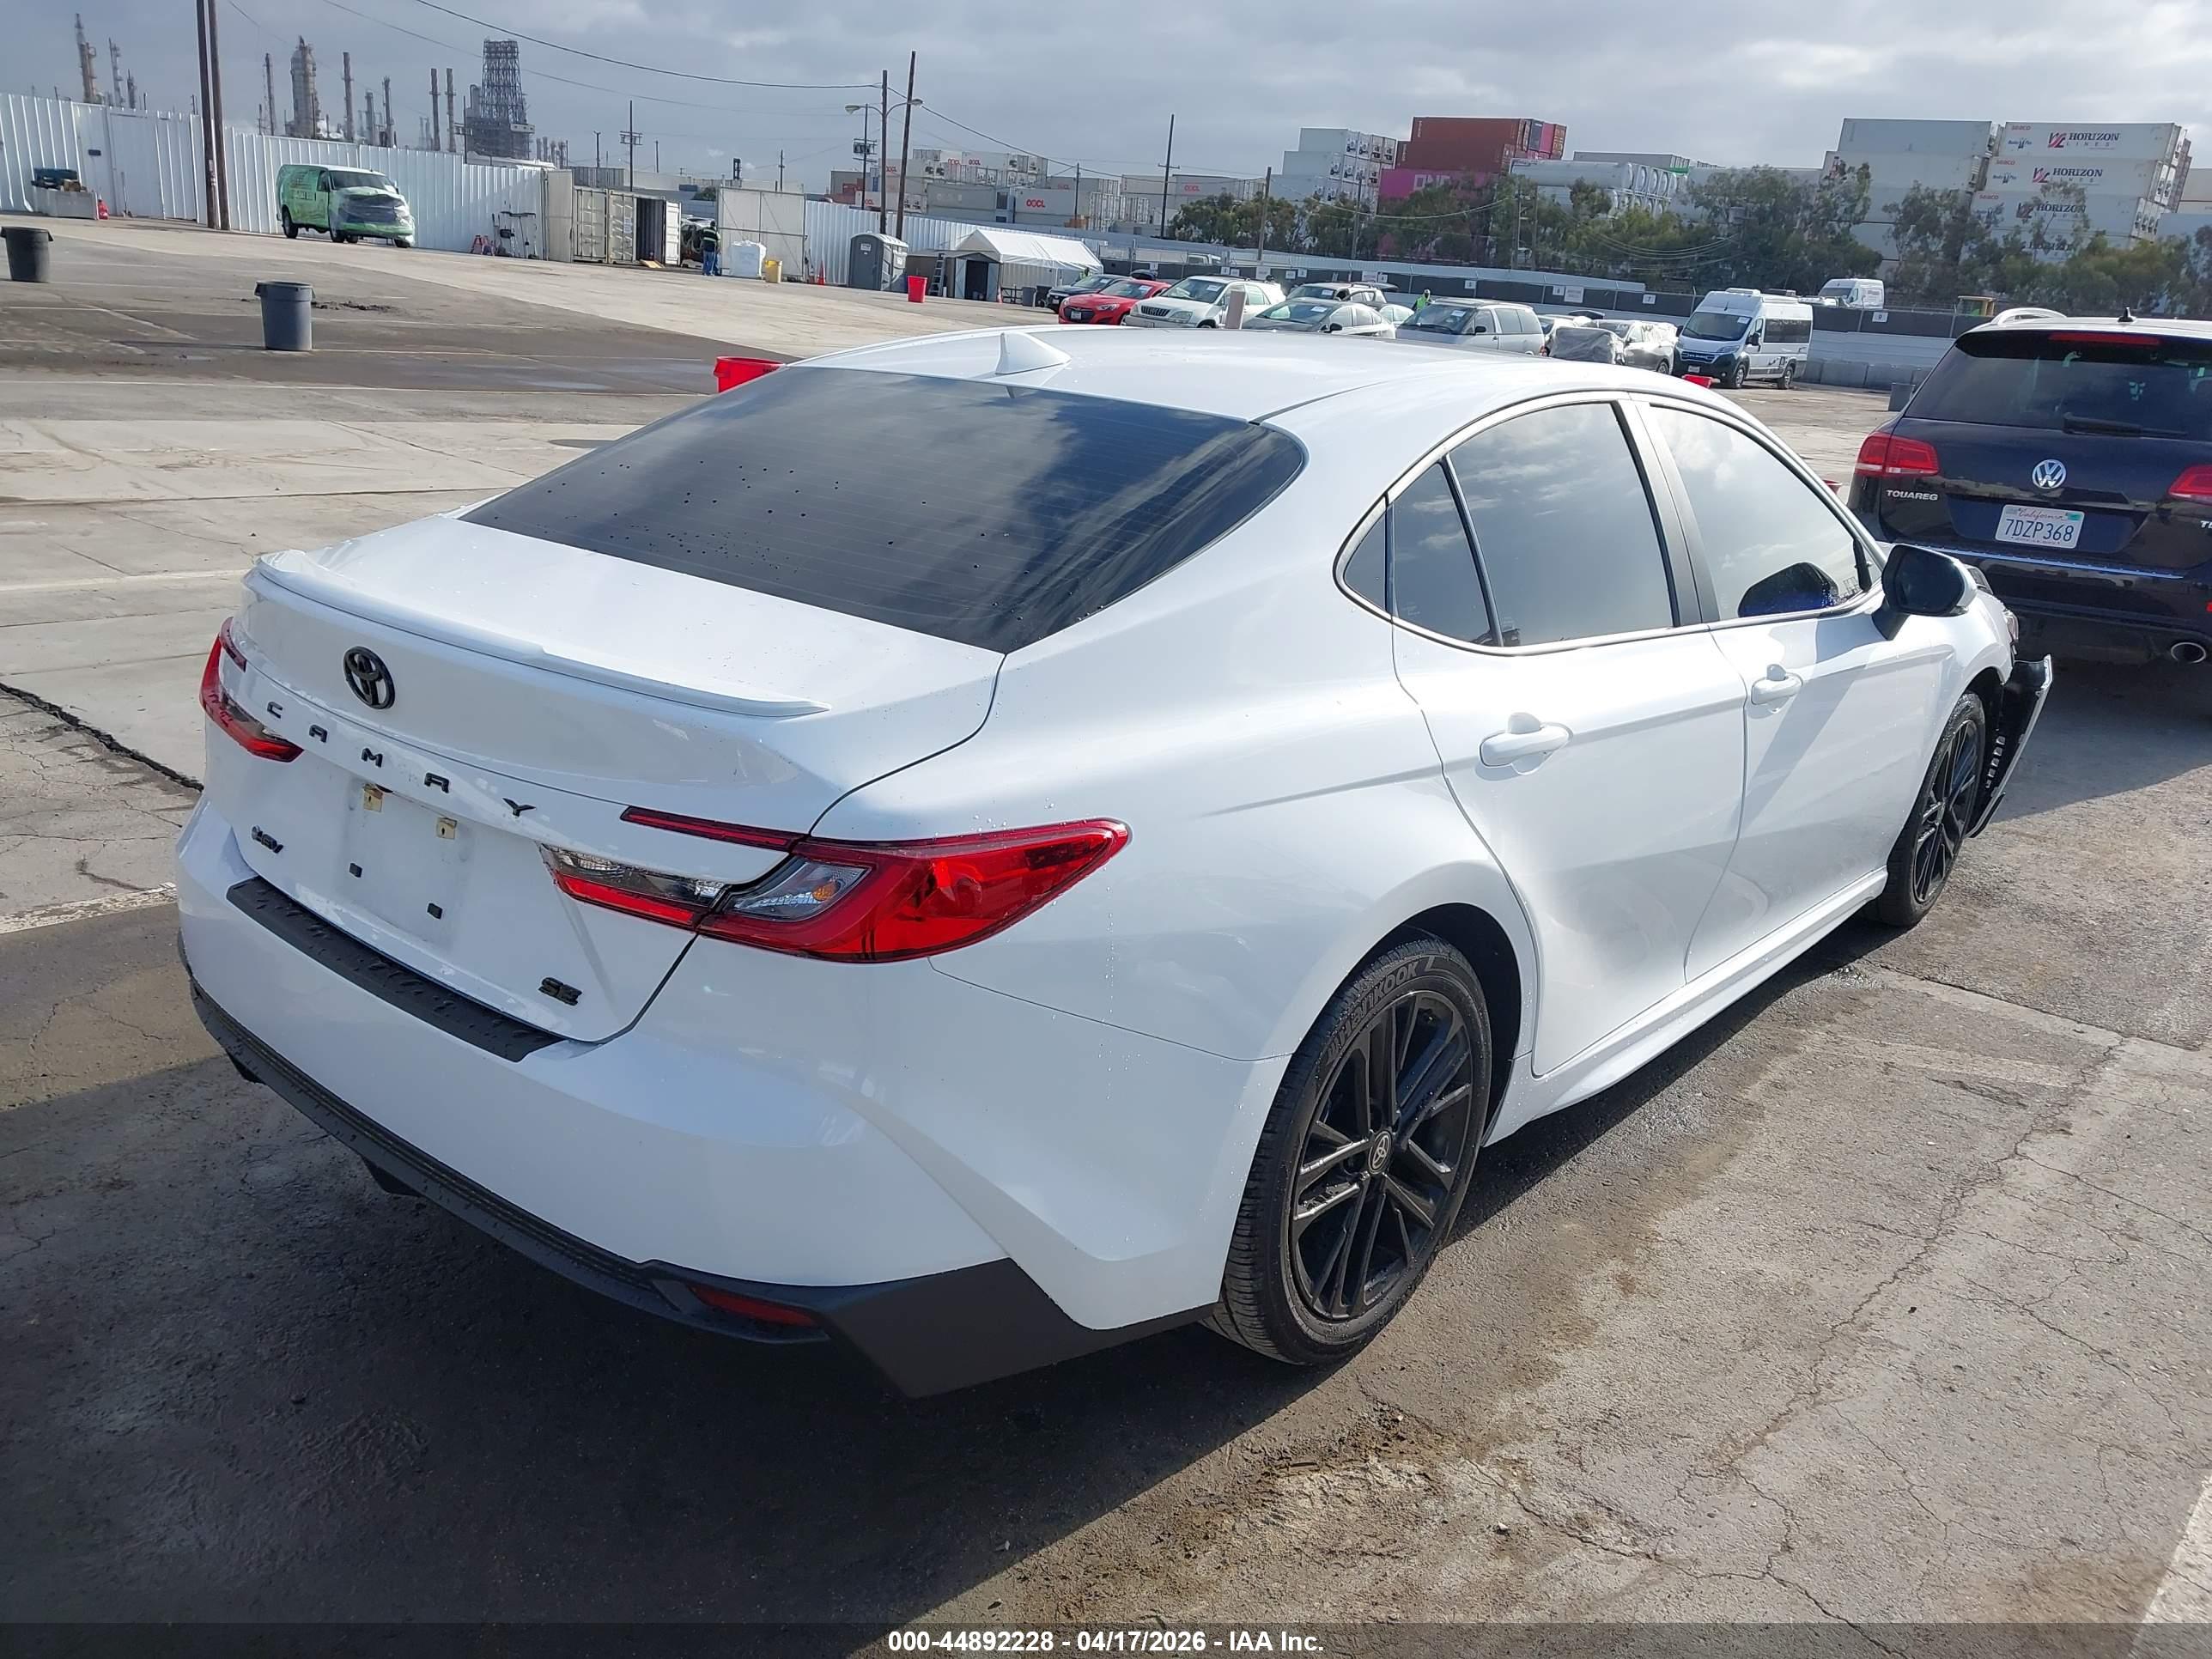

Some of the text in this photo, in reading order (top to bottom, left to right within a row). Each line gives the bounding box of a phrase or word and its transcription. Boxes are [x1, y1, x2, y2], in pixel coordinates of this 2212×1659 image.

[2069, 132, 2120, 141] HORIZON
[2052, 167, 2103, 177] HORIZON
[1026, 198, 1045, 208] OOCL
[1886, 489, 1938, 501] TOUAREG
[2005, 519, 2075, 542] 7DZP368
[267, 701, 537, 817] CAMRY
